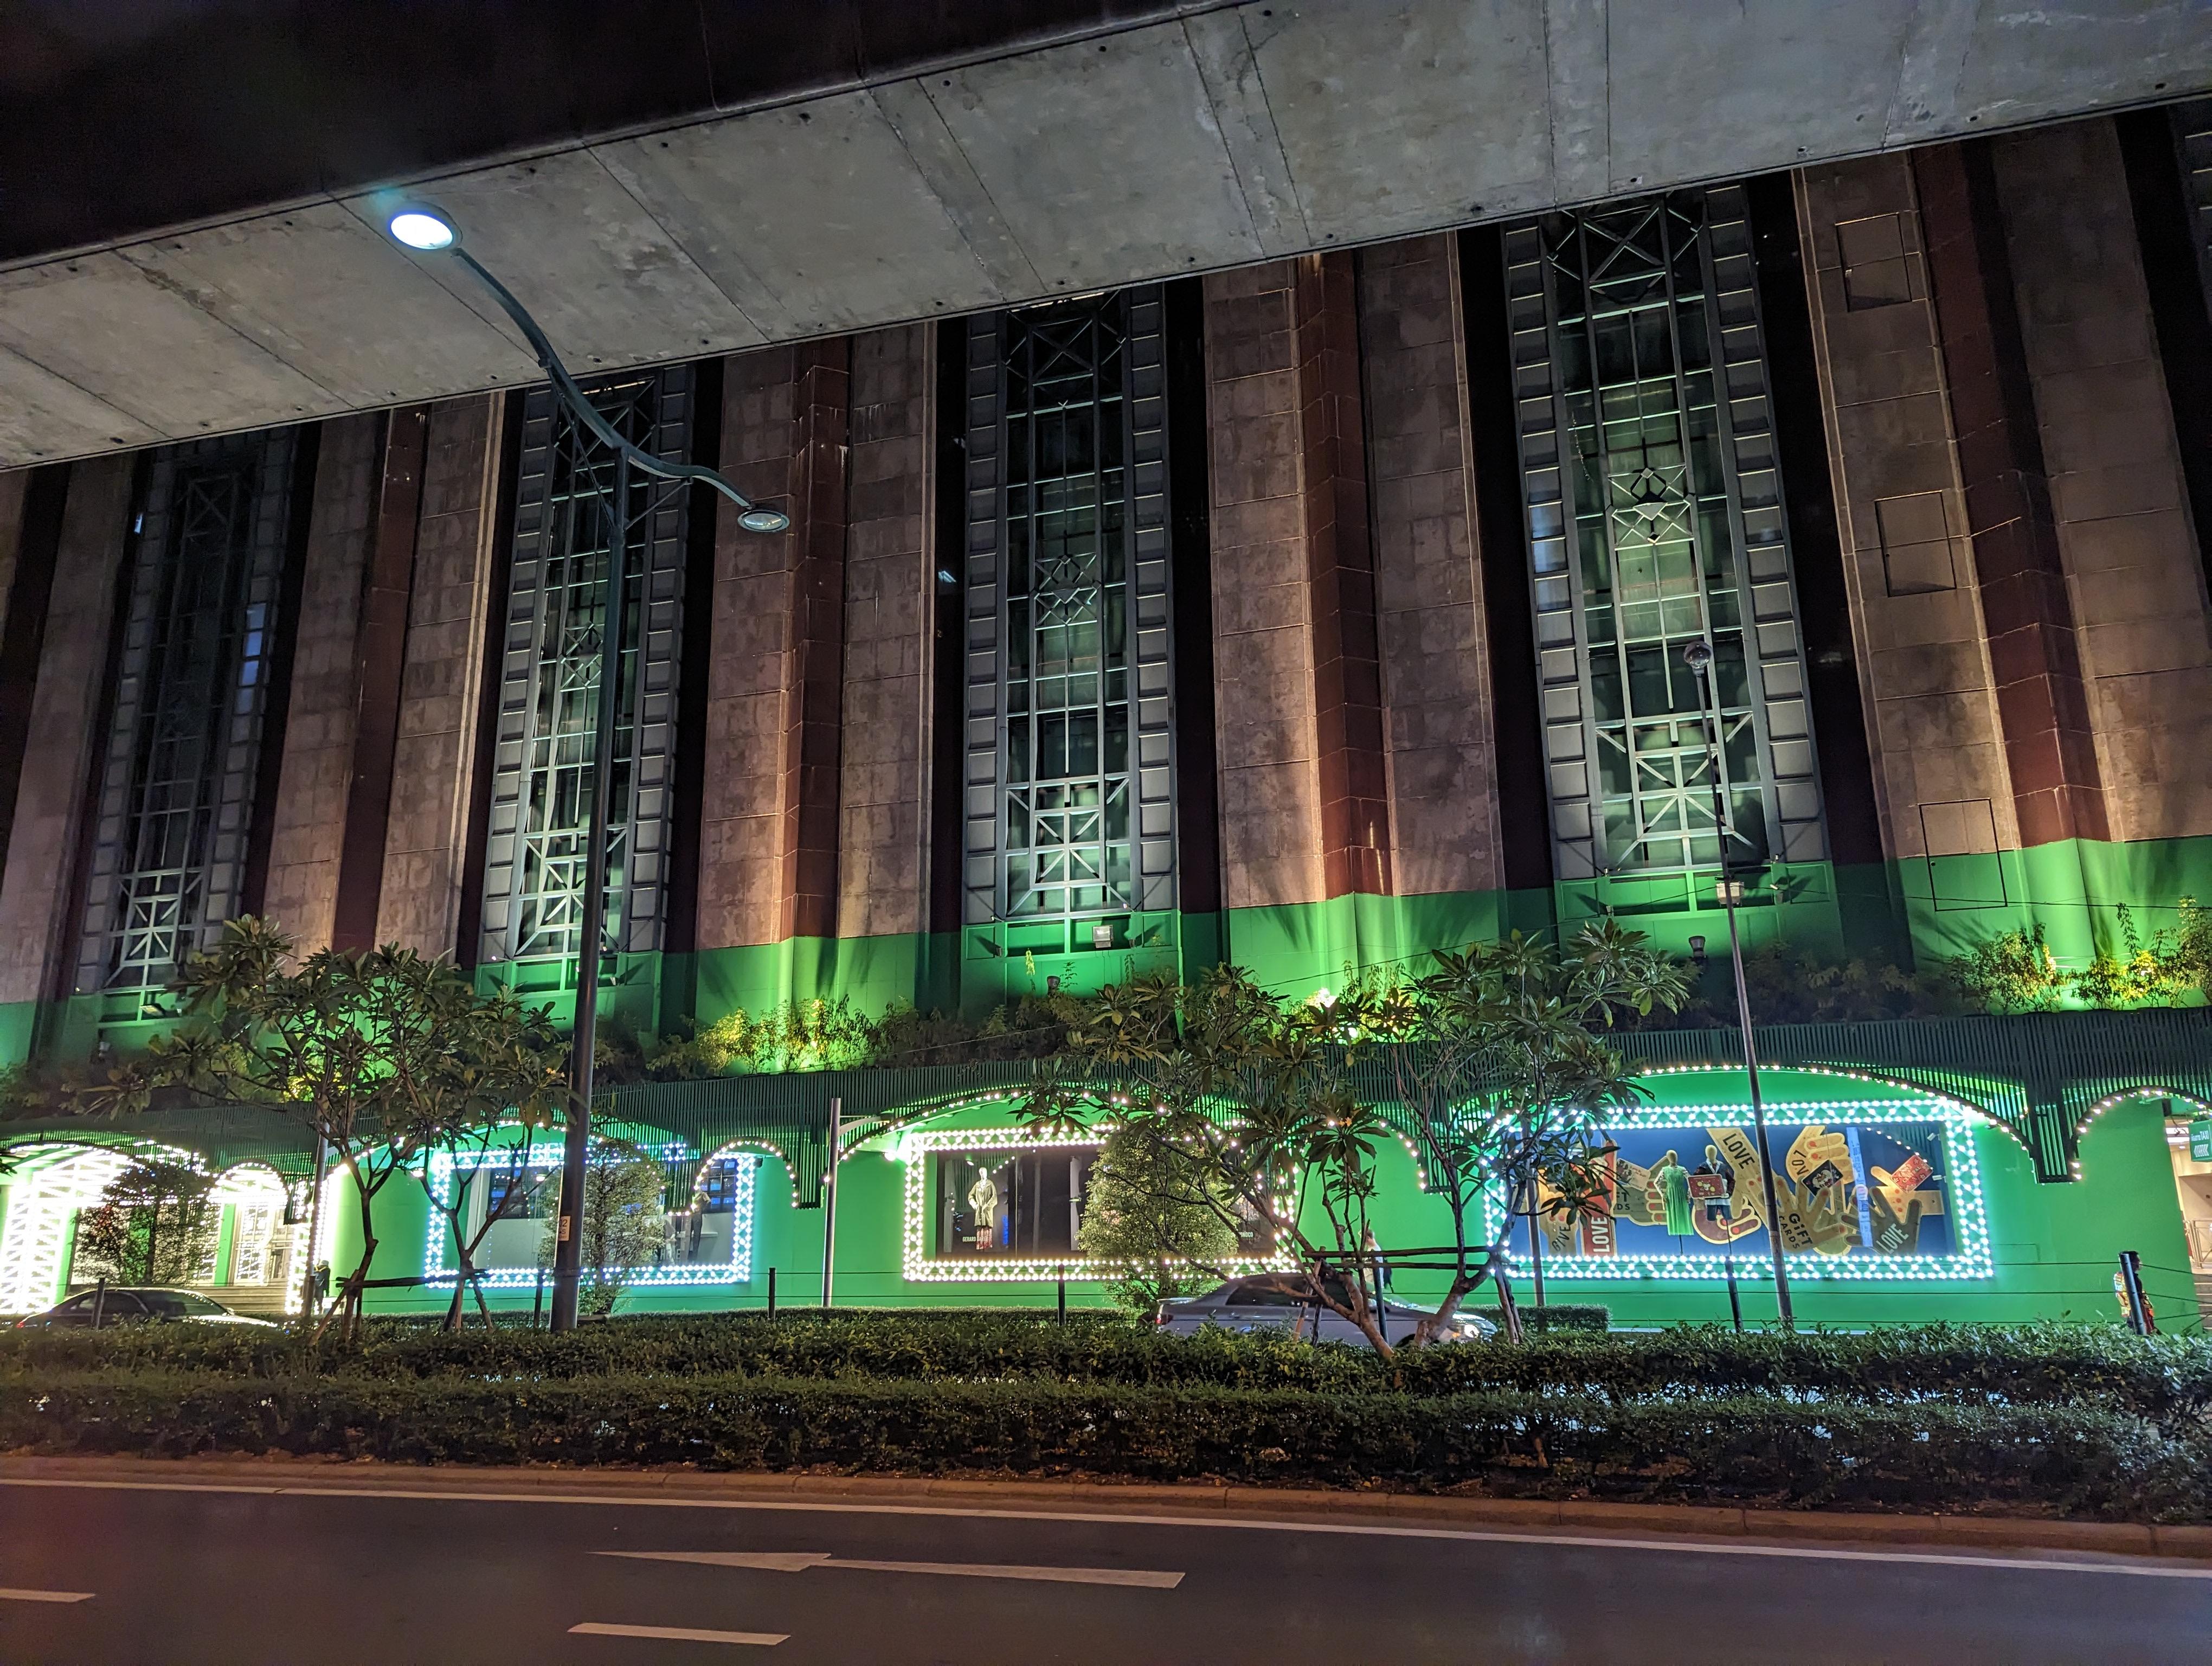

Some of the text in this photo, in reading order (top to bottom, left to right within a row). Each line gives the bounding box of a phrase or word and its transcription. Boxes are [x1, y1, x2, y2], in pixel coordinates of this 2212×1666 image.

[1722, 1133, 1755, 1169] LOVE
[1791, 1150, 1809, 1175] LOV
[1552, 1225, 1571, 1252] GIVE
[1591, 1216, 1610, 1252] LOVE
[1779, 1216, 1799, 1249] CARDS
[1876, 1223, 1909, 1254] LOVE
